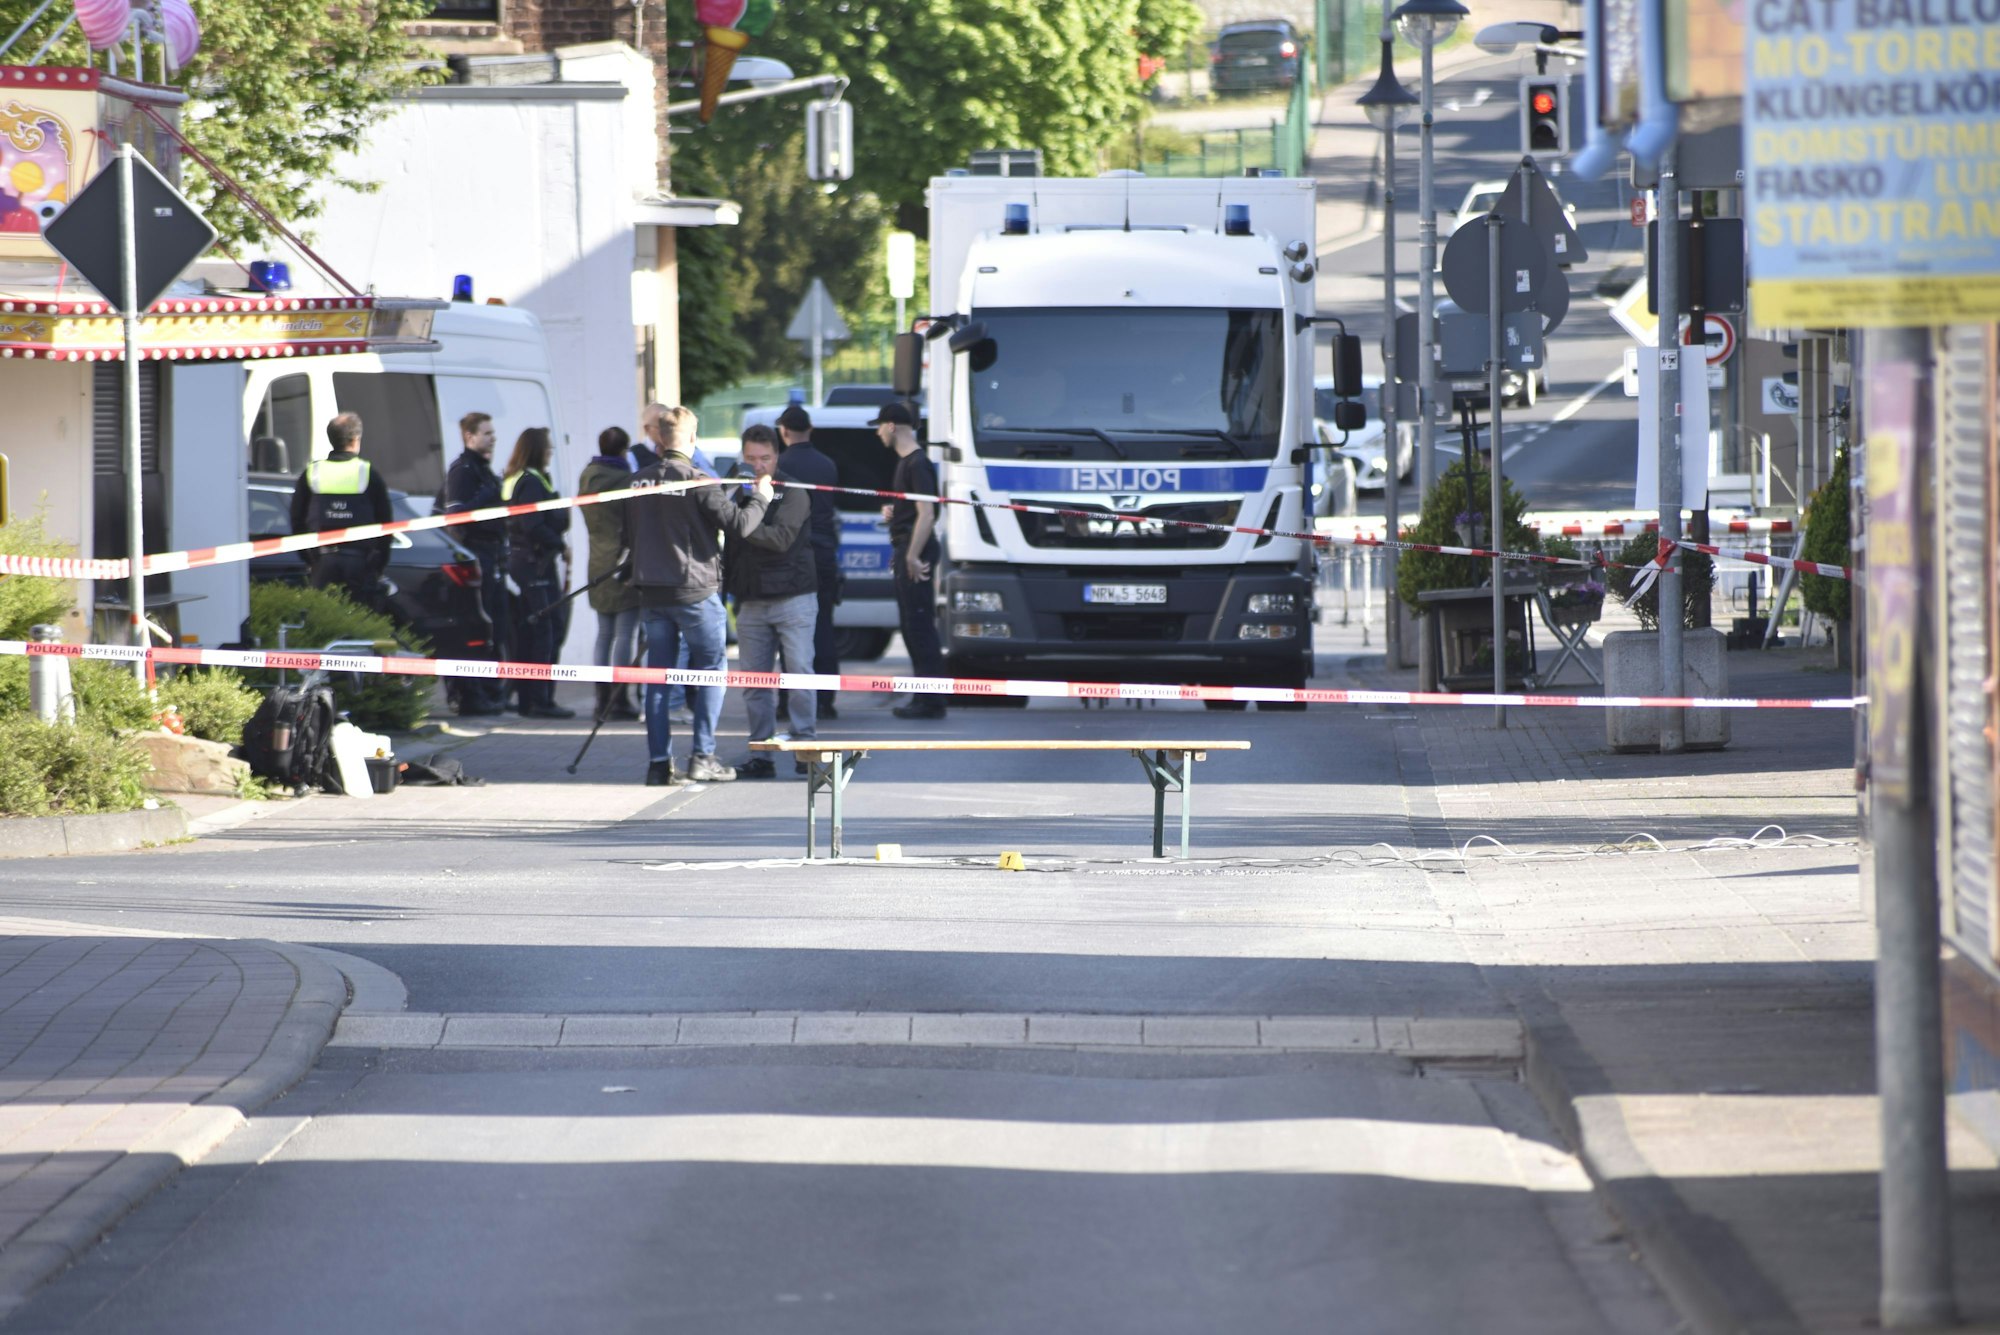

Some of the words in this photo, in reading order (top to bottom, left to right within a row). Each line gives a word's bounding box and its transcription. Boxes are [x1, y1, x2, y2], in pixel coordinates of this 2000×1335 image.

[1755, 0, 1835, 34] CAT
[1756, 165, 1884, 199] FIASKO
[332, 501, 348, 510] VU
[325, 511, 353, 519] Team
[26, 644, 152, 659] POLIZEIABSPERRUNG
[242, 655, 366, 668] POLIZEIABSPERRUNG
[455, 665, 577, 678] POLIZEIABSPERRUNG
[665, 674, 785, 686] POLIZEIABSPERRUNG
